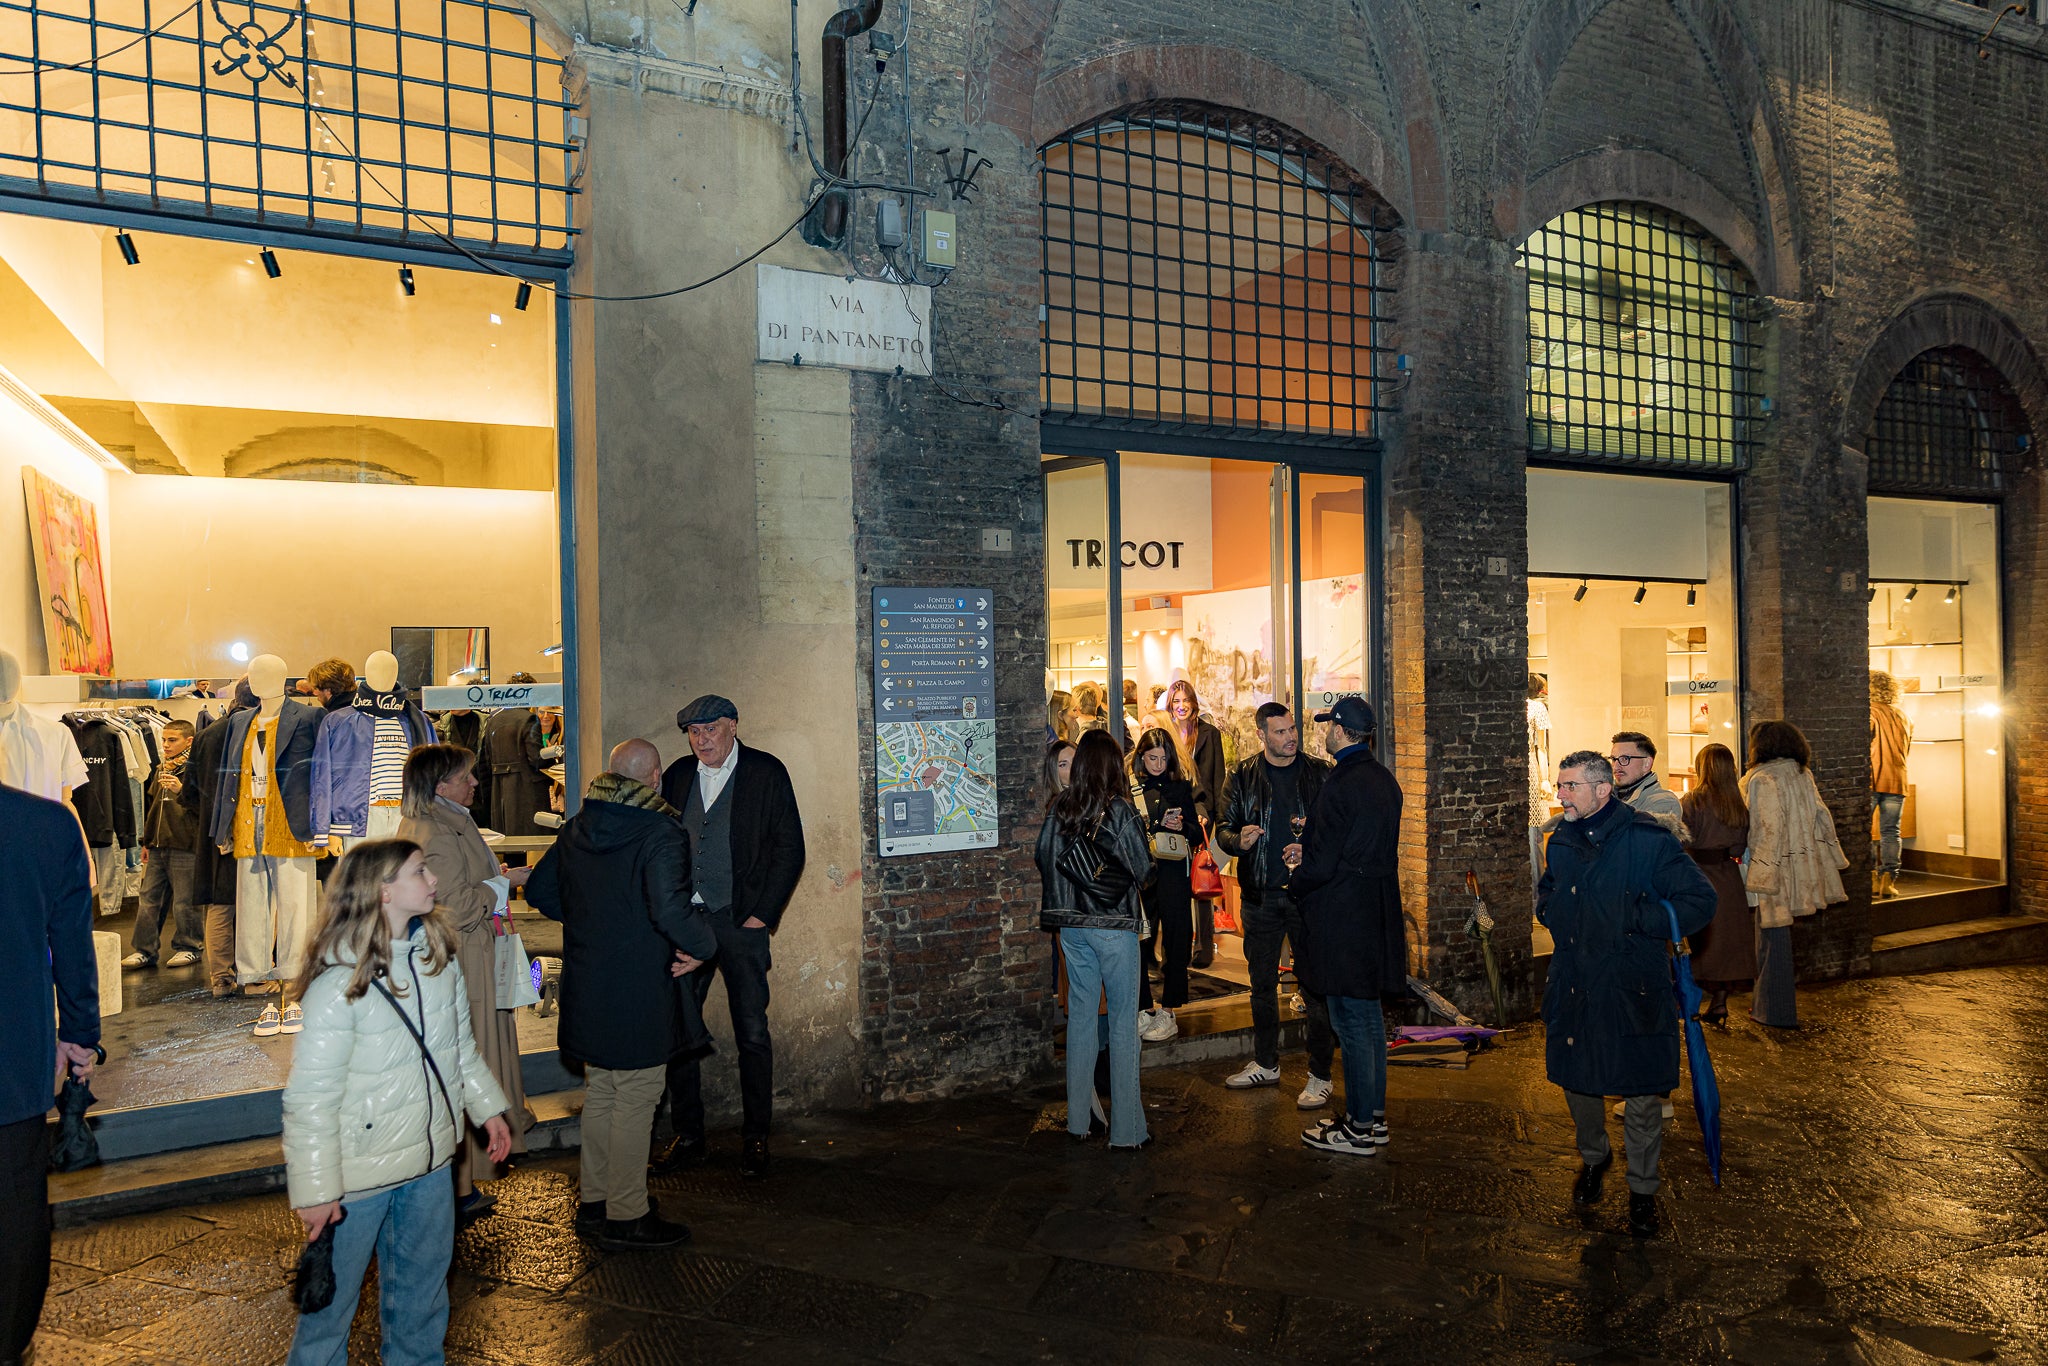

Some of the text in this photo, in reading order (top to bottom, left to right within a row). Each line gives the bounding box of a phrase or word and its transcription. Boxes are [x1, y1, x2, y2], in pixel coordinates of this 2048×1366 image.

[829, 294, 865, 314] VIA
[768, 322, 924, 354] DI PANTANETO
[1066, 539, 1185, 569] TRCOT
[1495, 560, 1501, 572] 3
[351, 692, 373, 707] Chez
[488, 687, 532, 701] TRICOT
